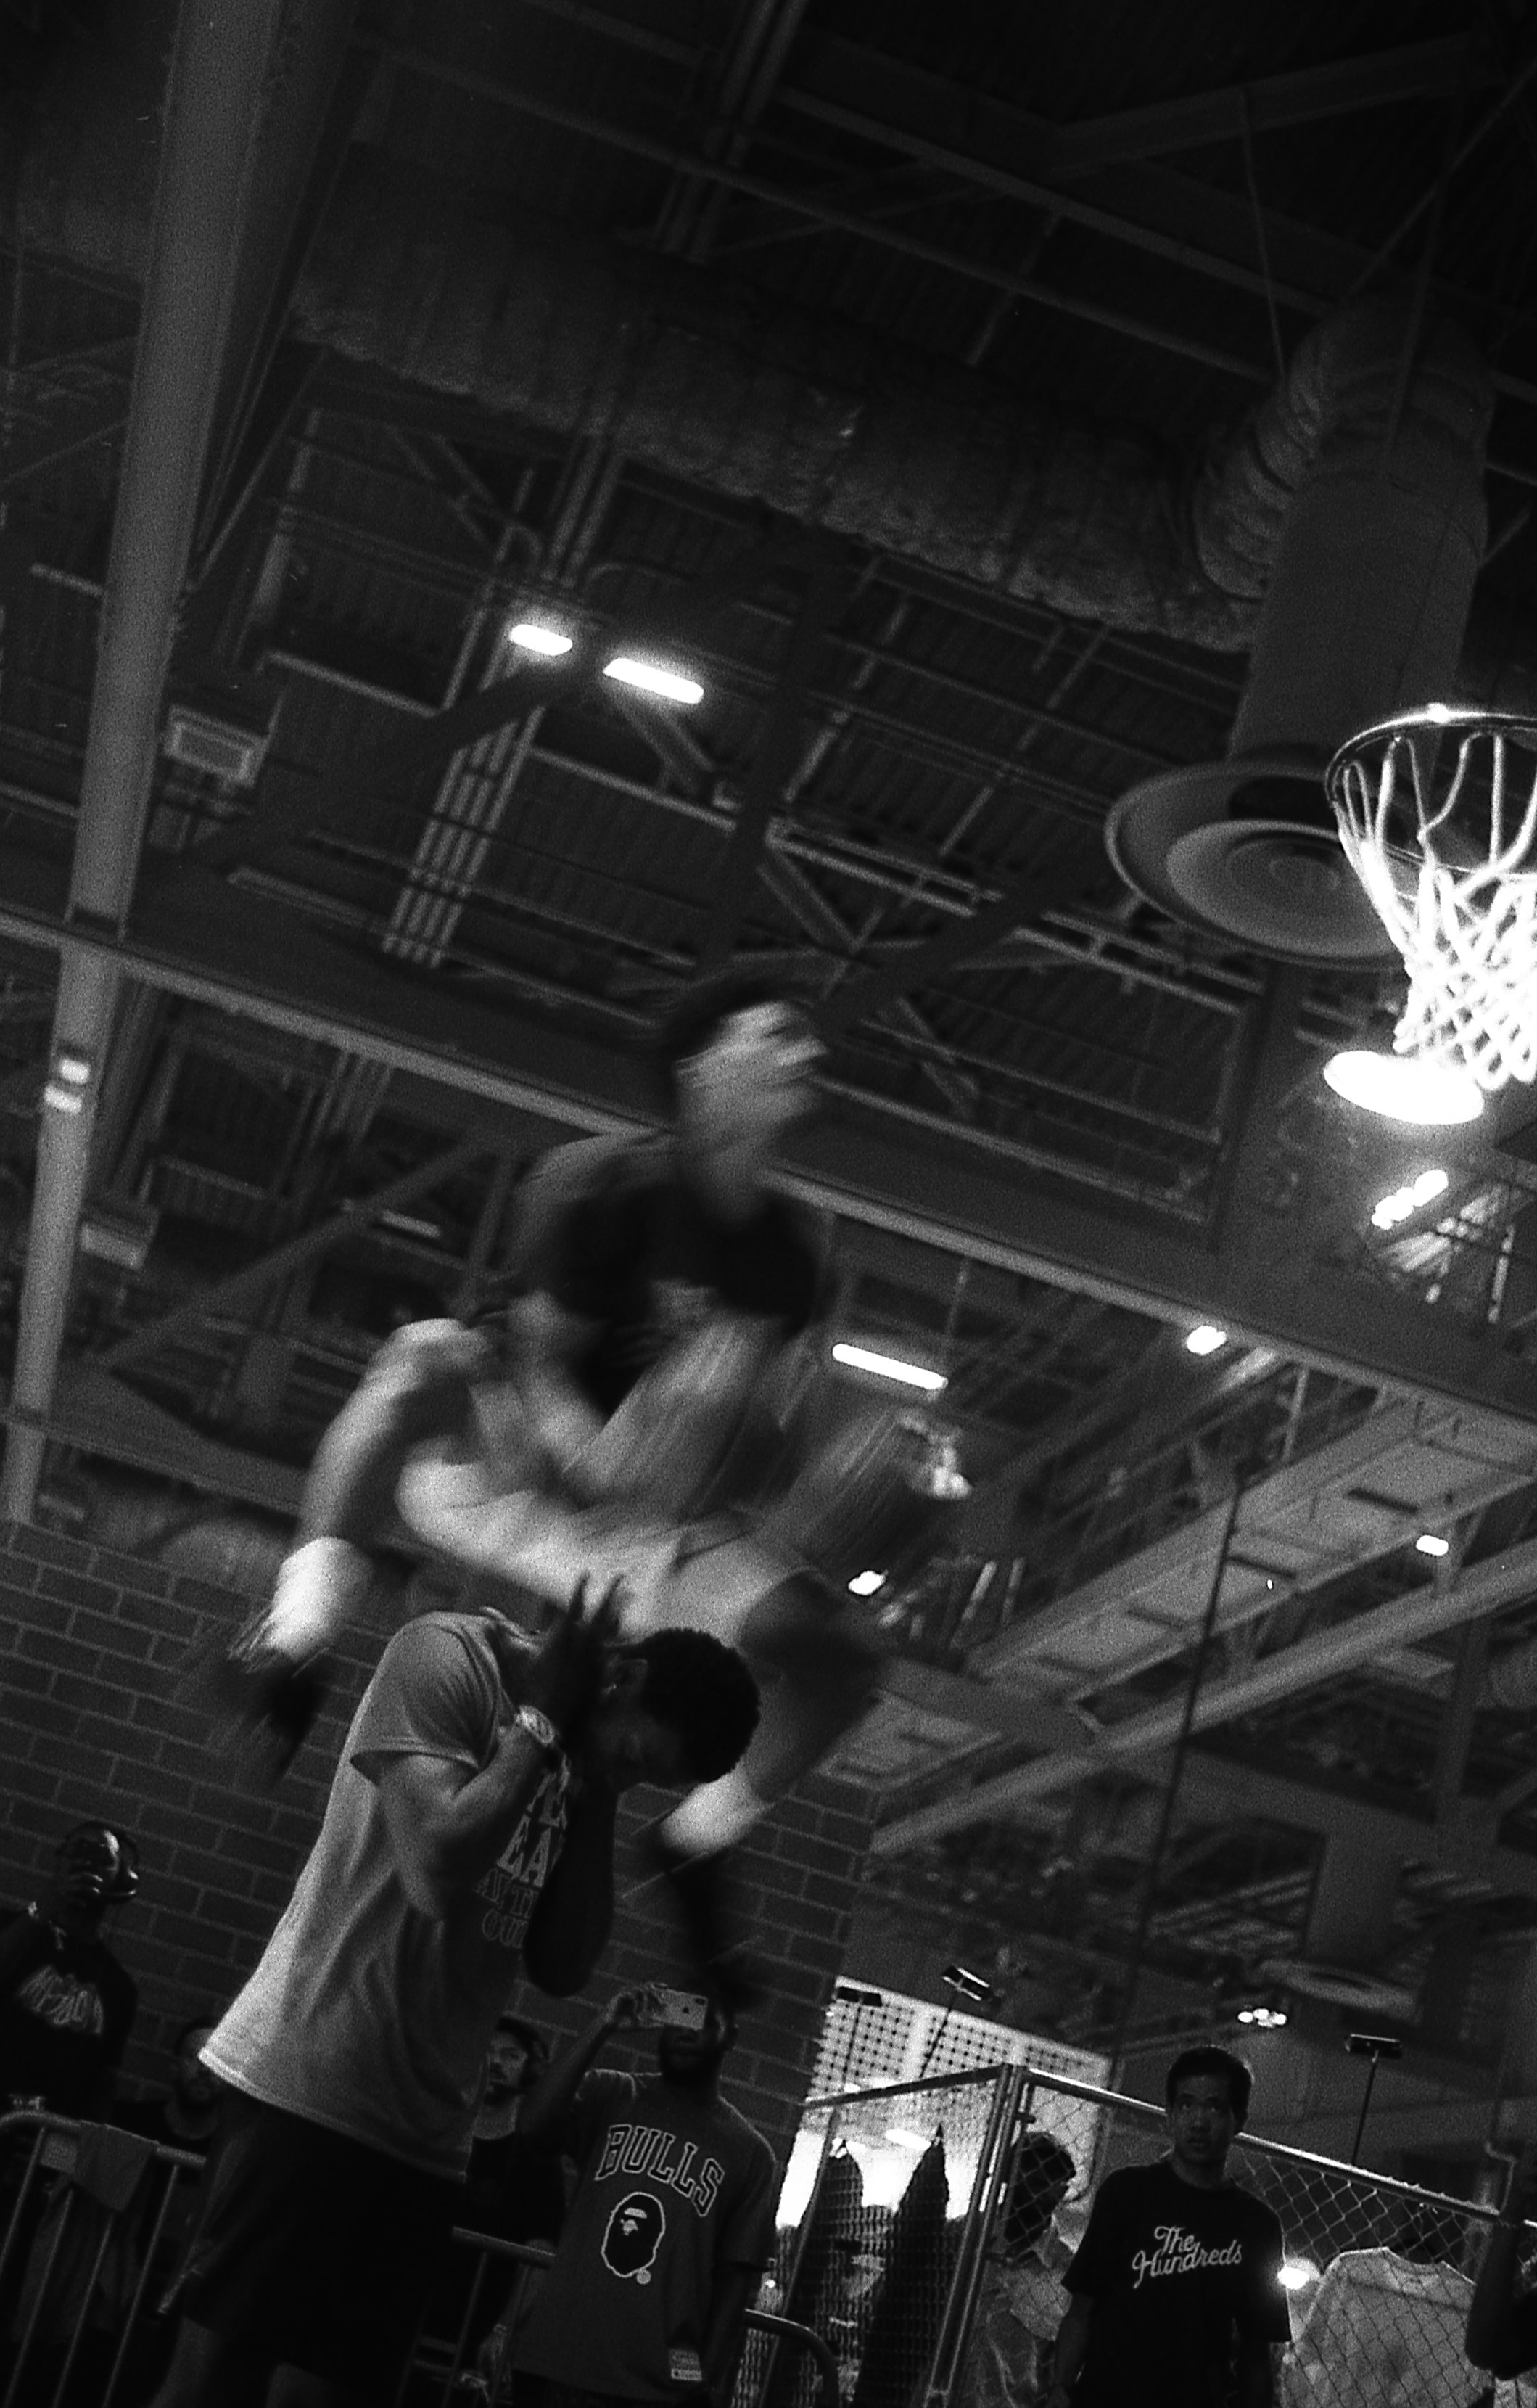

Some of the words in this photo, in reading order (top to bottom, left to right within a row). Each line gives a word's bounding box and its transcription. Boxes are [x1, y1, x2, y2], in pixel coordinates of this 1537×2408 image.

[594, 2123, 725, 2217] BULLS
[1132, 2239, 1243, 2290] Hundreds
[1153, 2224, 1195, 2255] The
